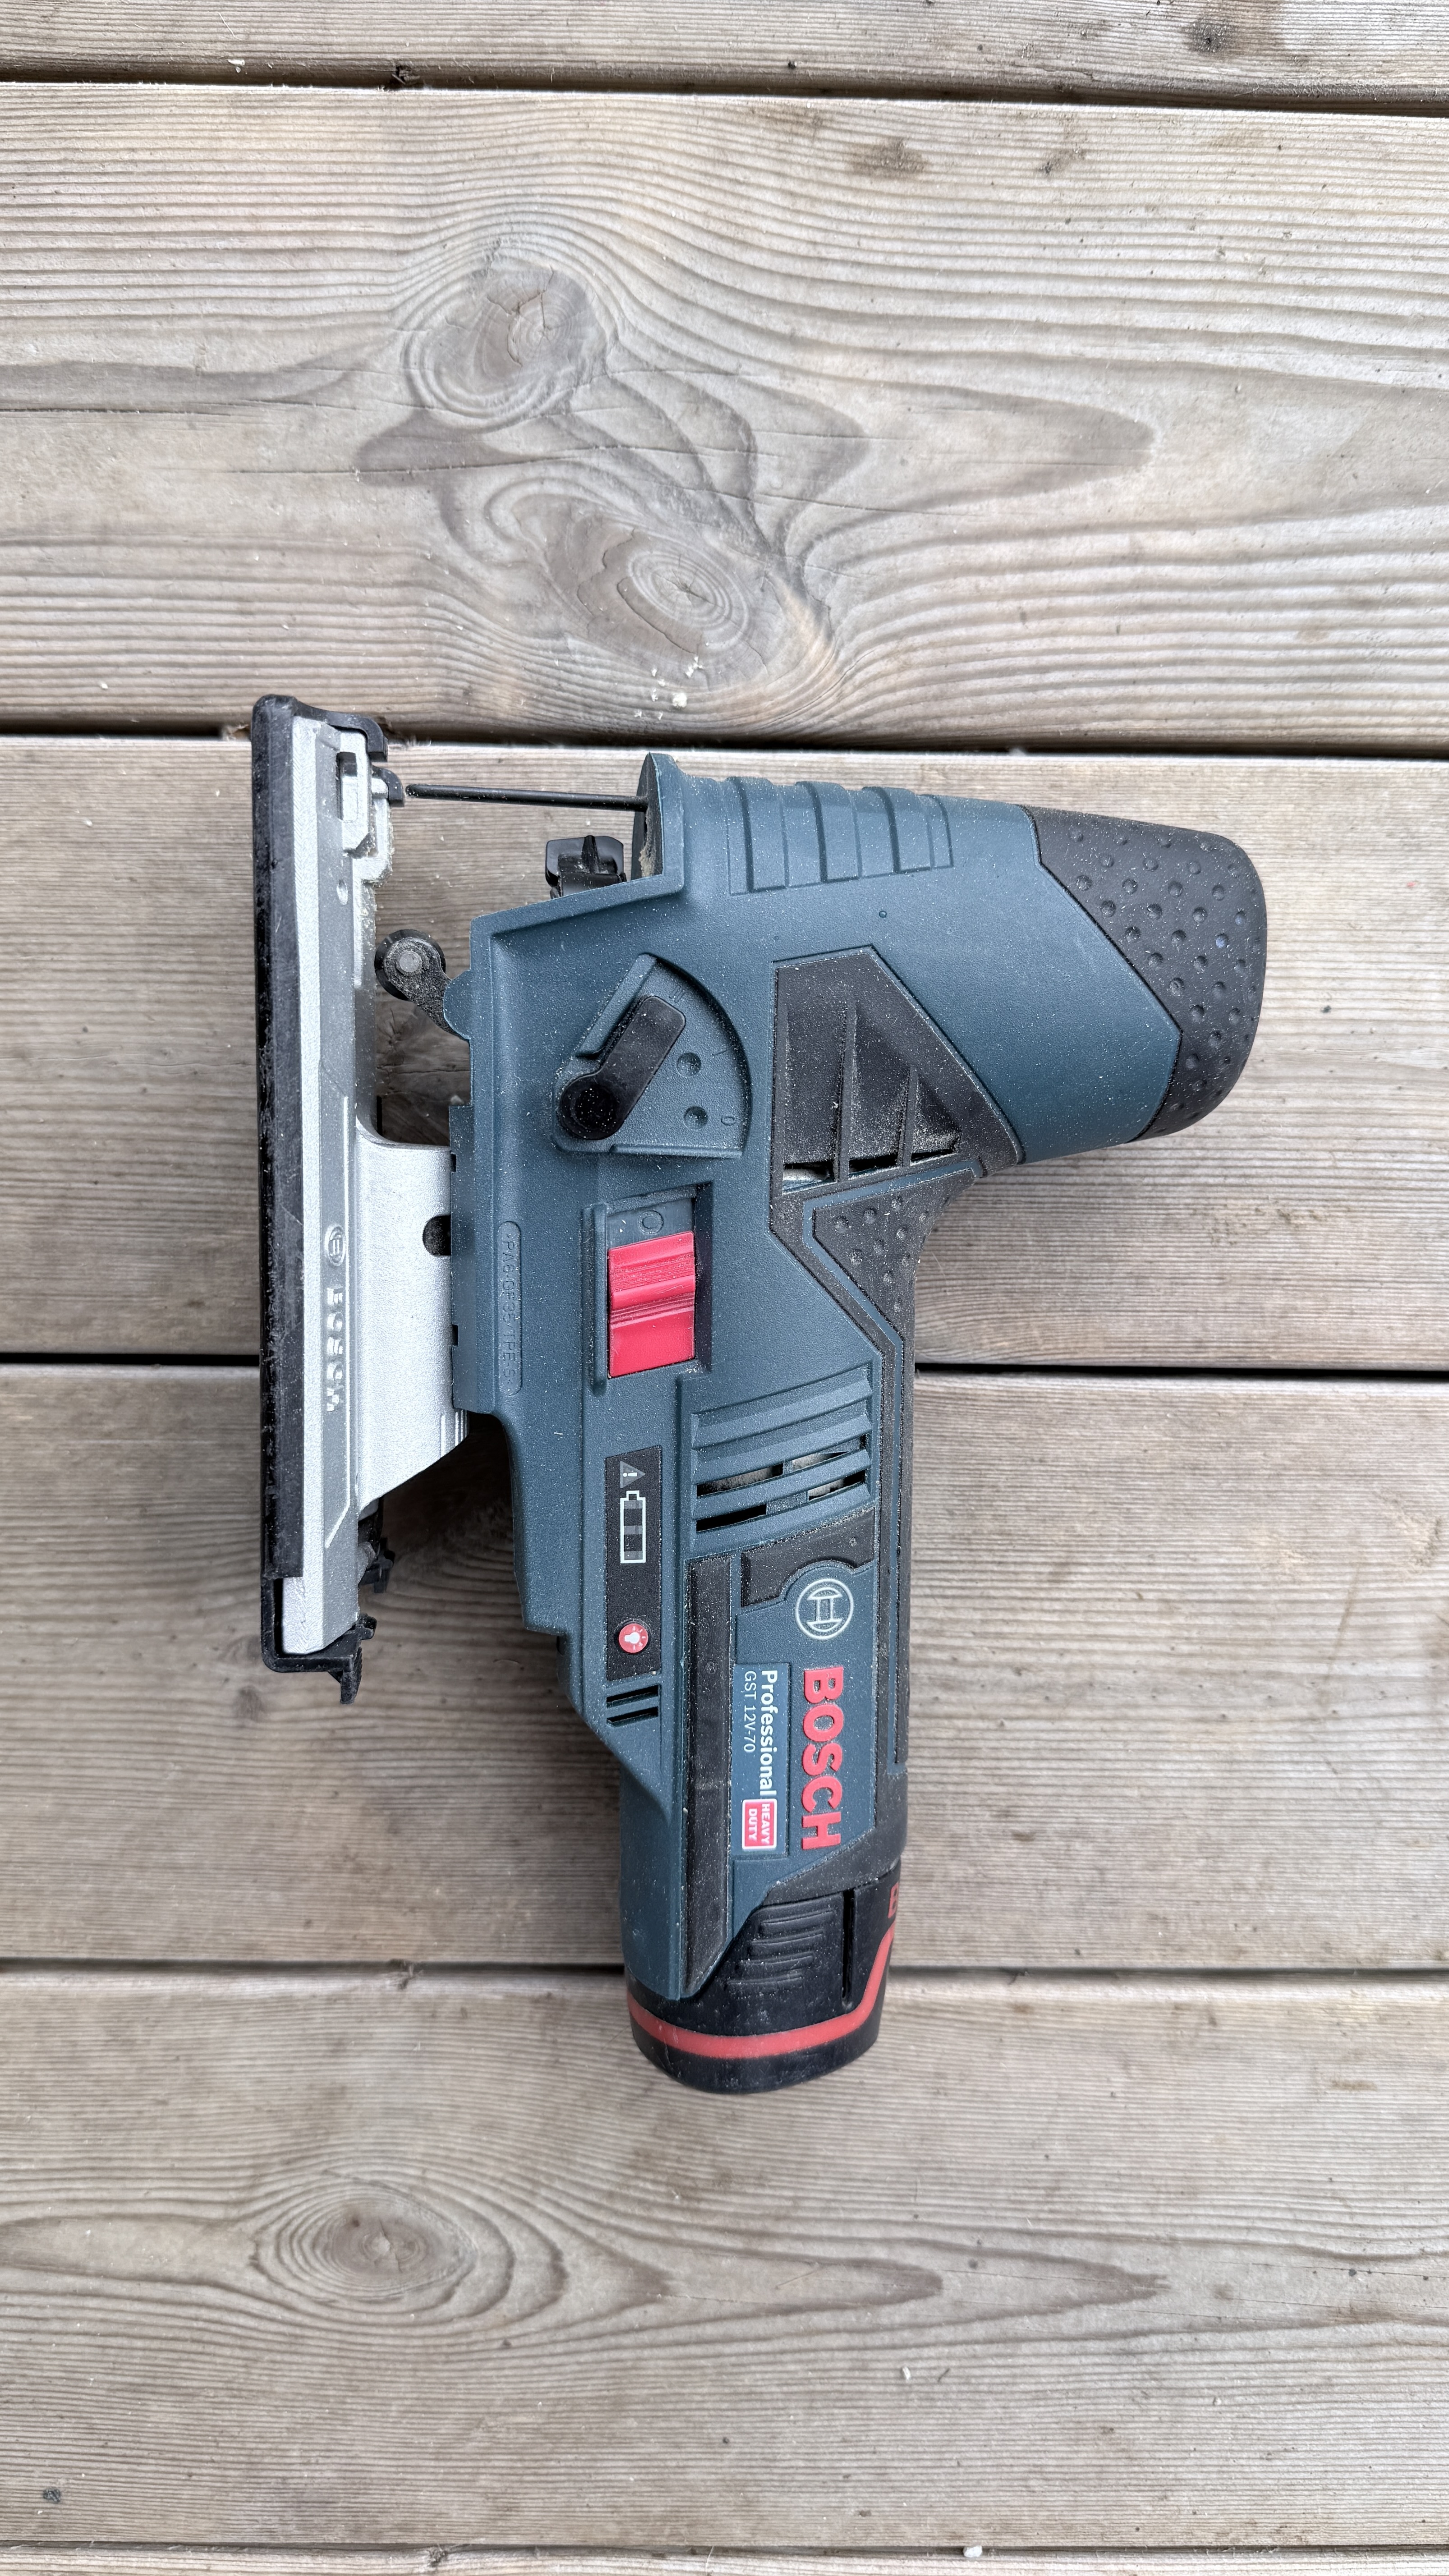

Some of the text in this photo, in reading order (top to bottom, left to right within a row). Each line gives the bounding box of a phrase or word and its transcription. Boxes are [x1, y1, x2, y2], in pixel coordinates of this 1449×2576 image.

[743, 1670, 757, 1753] GST 12V-70
[759, 1670, 778, 1796] Professional
[801, 1665, 844, 1850] BOSCH
[748, 1808, 758, 1841] DUTY
[760, 1803, 771, 1845] HEAVY
